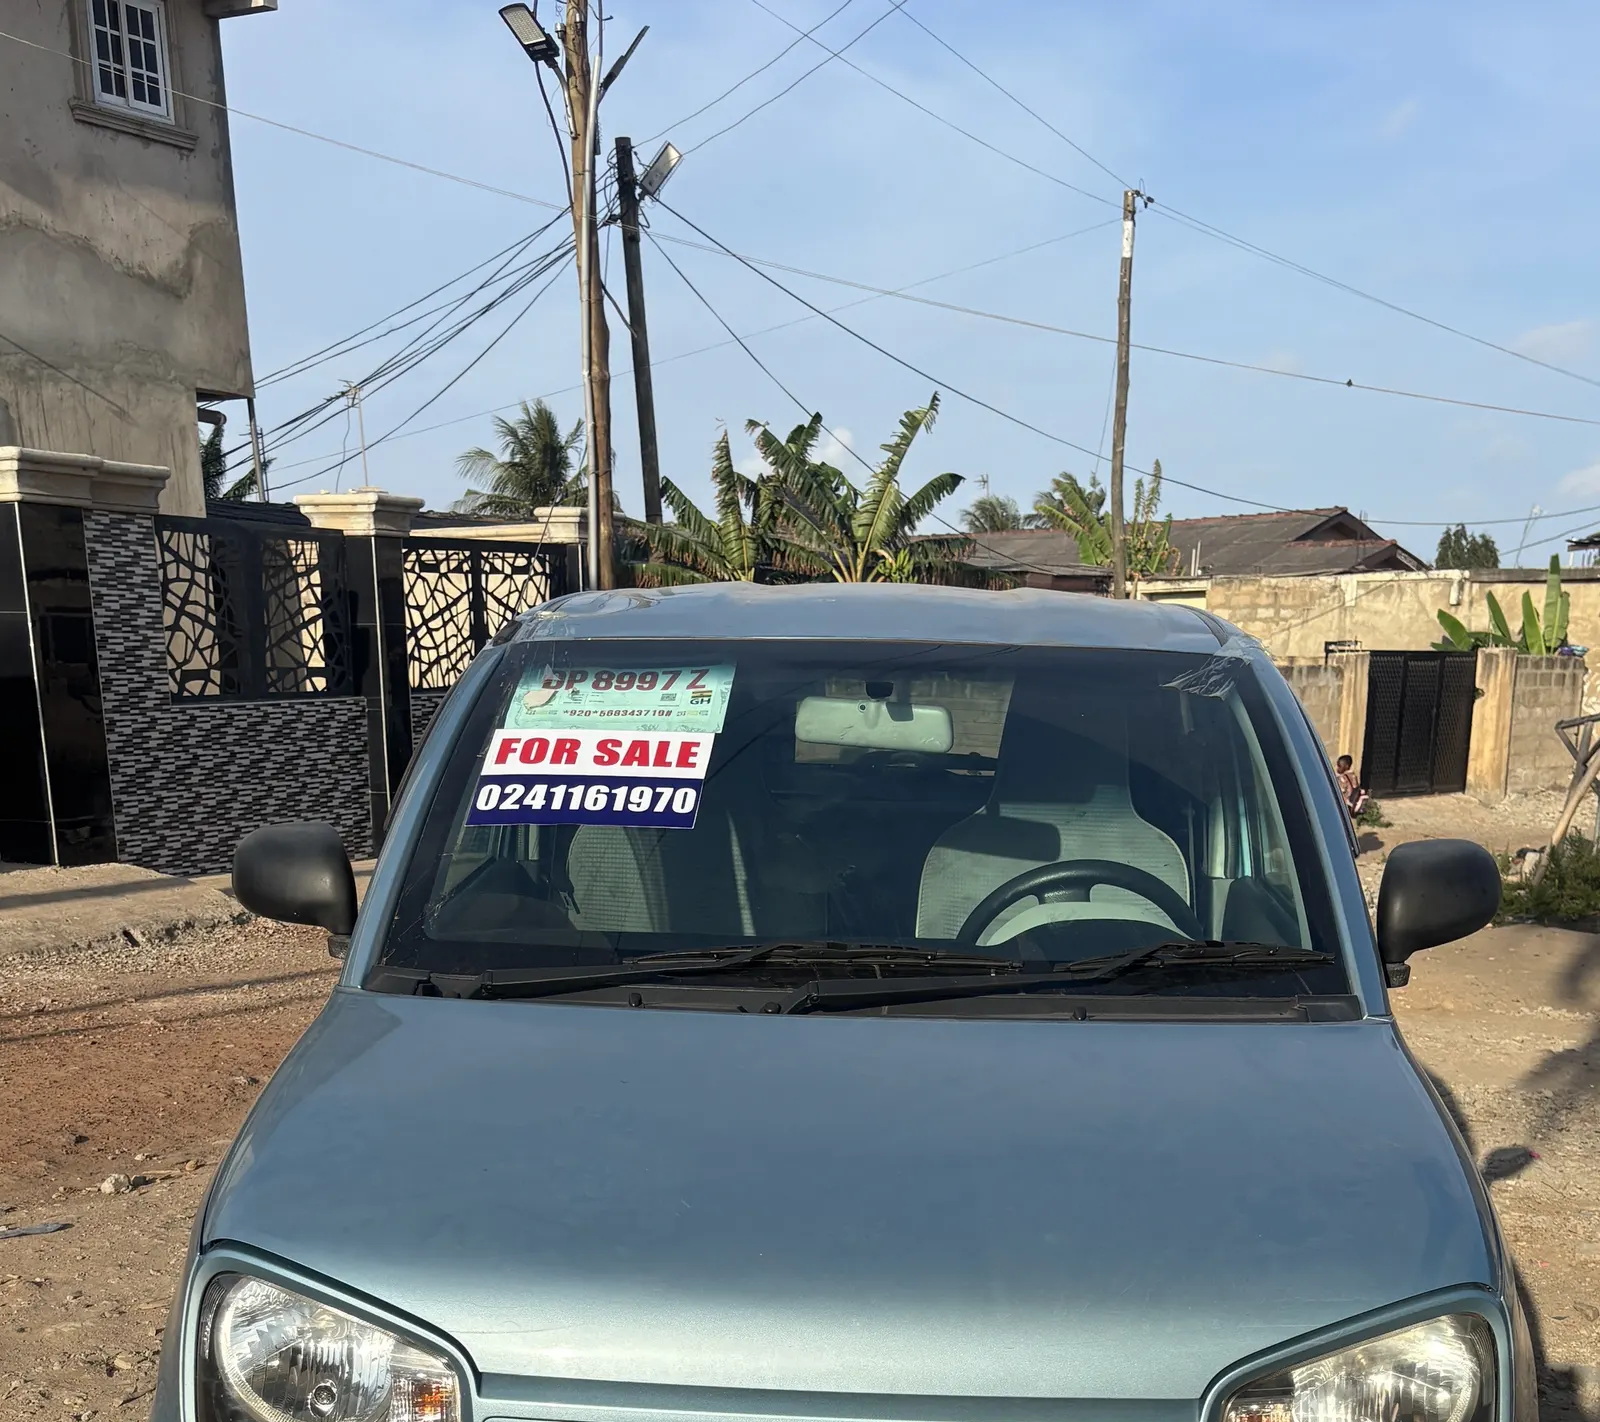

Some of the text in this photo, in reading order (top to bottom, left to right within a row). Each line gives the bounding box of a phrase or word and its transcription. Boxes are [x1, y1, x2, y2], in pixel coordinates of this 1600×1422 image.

[591, 670, 682, 691] 8997
[686, 668, 710, 690] Z
[494, 737, 701, 768] FOR SALE
[475, 783, 698, 814] 0241161970
